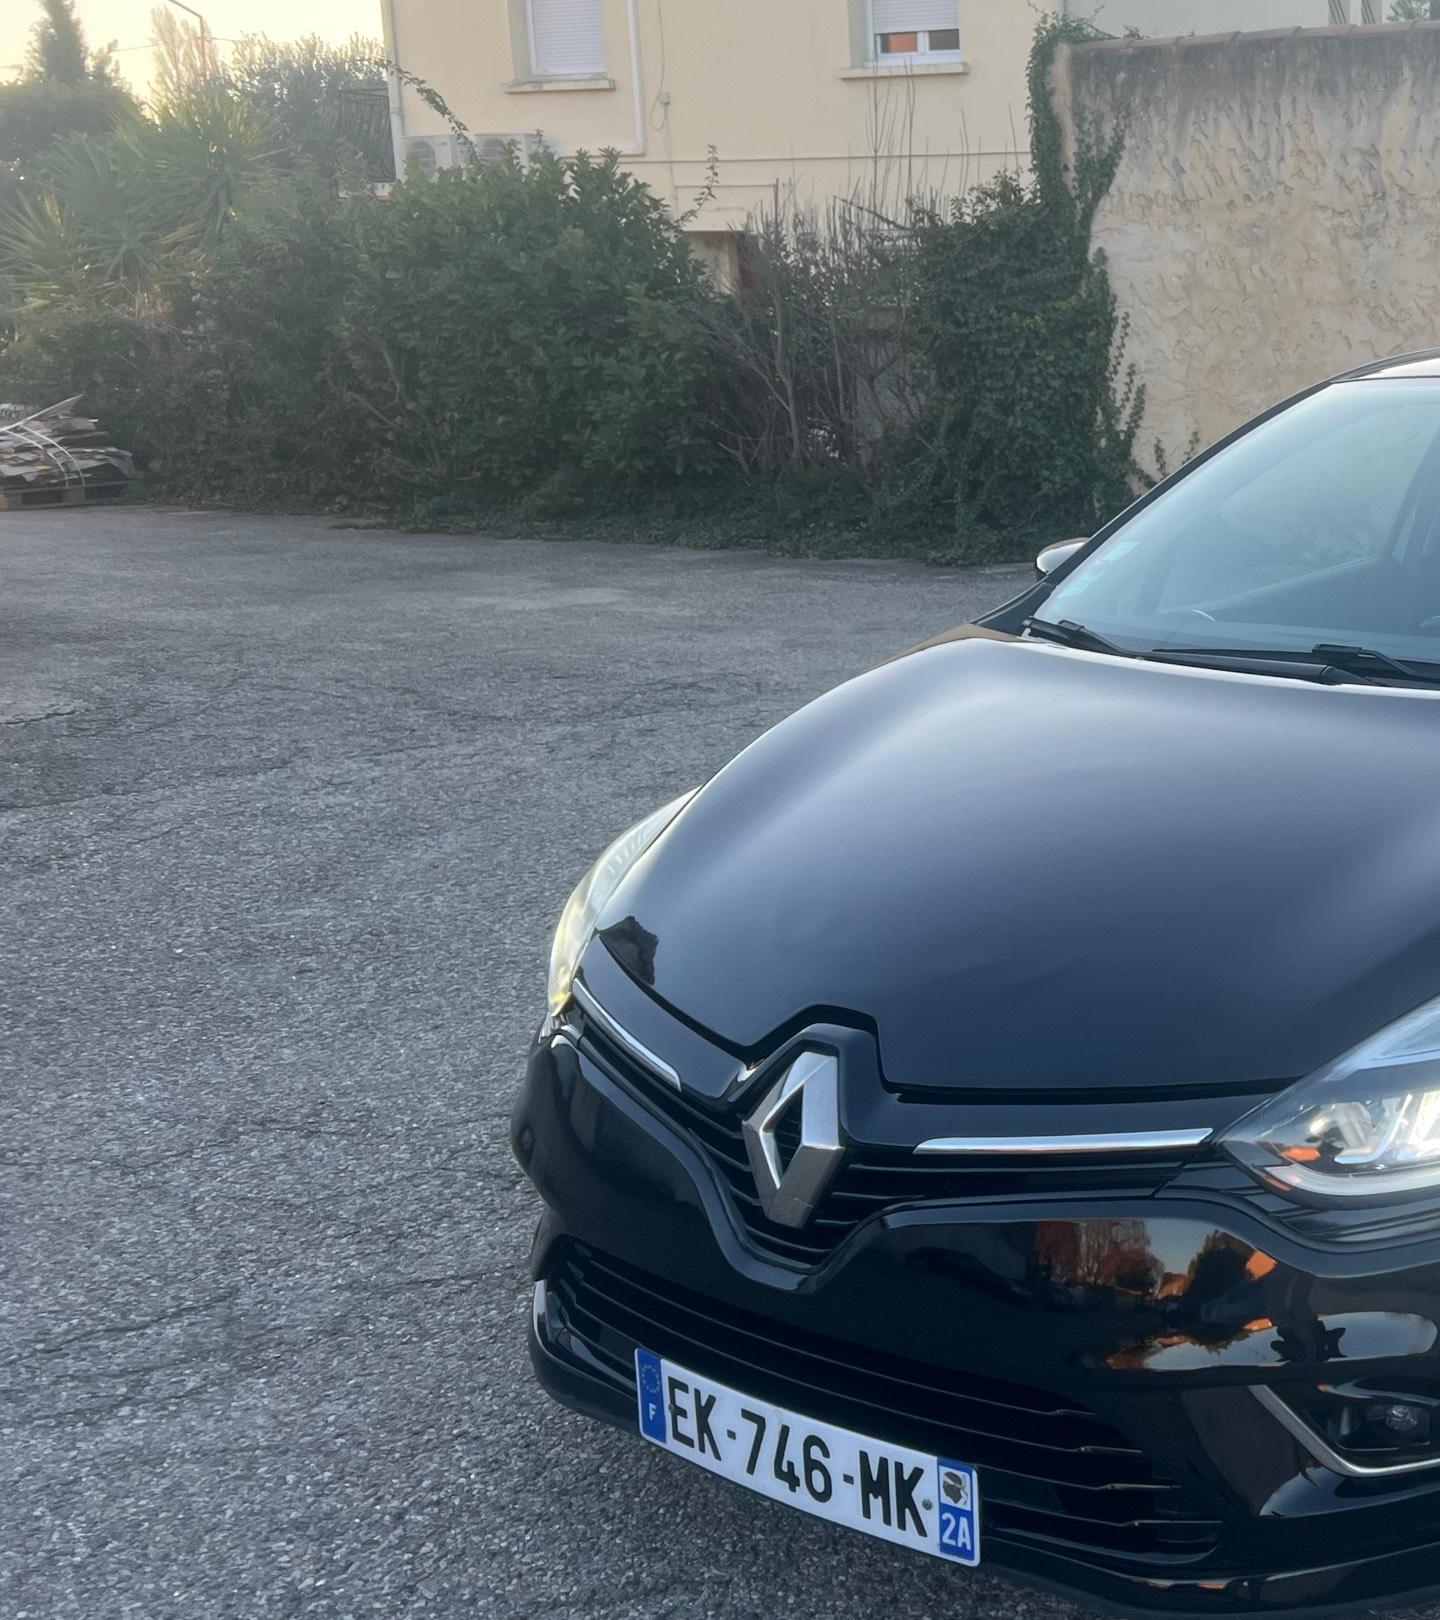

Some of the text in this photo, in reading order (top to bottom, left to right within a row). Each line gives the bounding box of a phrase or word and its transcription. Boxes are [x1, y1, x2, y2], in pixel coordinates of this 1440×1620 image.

[648, 1402, 657, 1421] F
[668, 1376, 928, 1538] EK-746-MK
[941, 1511, 972, 1551] 2A
